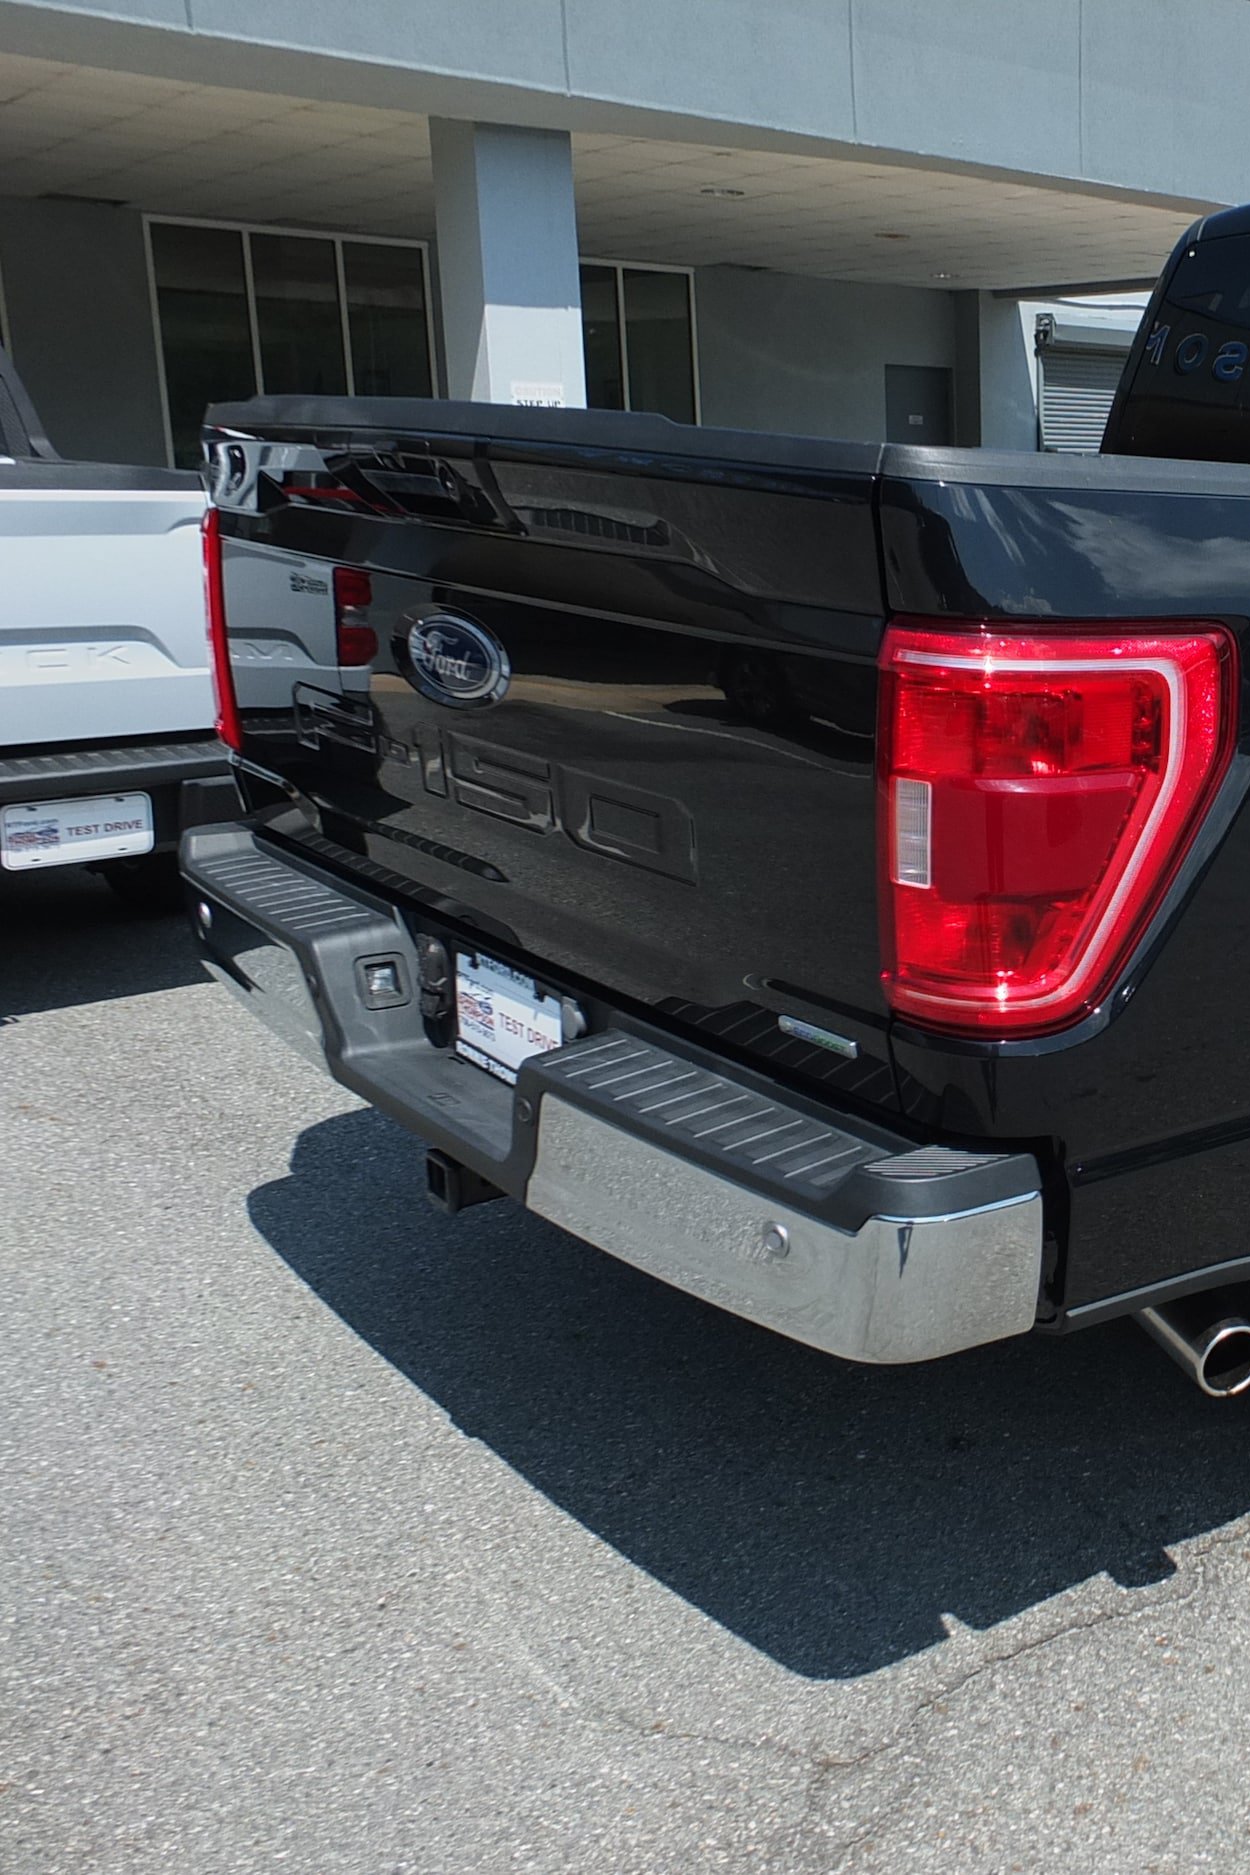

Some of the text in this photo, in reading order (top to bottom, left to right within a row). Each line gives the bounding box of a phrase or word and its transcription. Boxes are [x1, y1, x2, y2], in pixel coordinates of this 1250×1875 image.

[0, 645, 132, 669] CK
[421, 629, 481, 683] Ford
[293, 681, 698, 887] F-150
[66, 823, 101, 837] TEST
[104, 818, 144, 833] DRIVE
[499, 1012, 524, 1039] TEST
